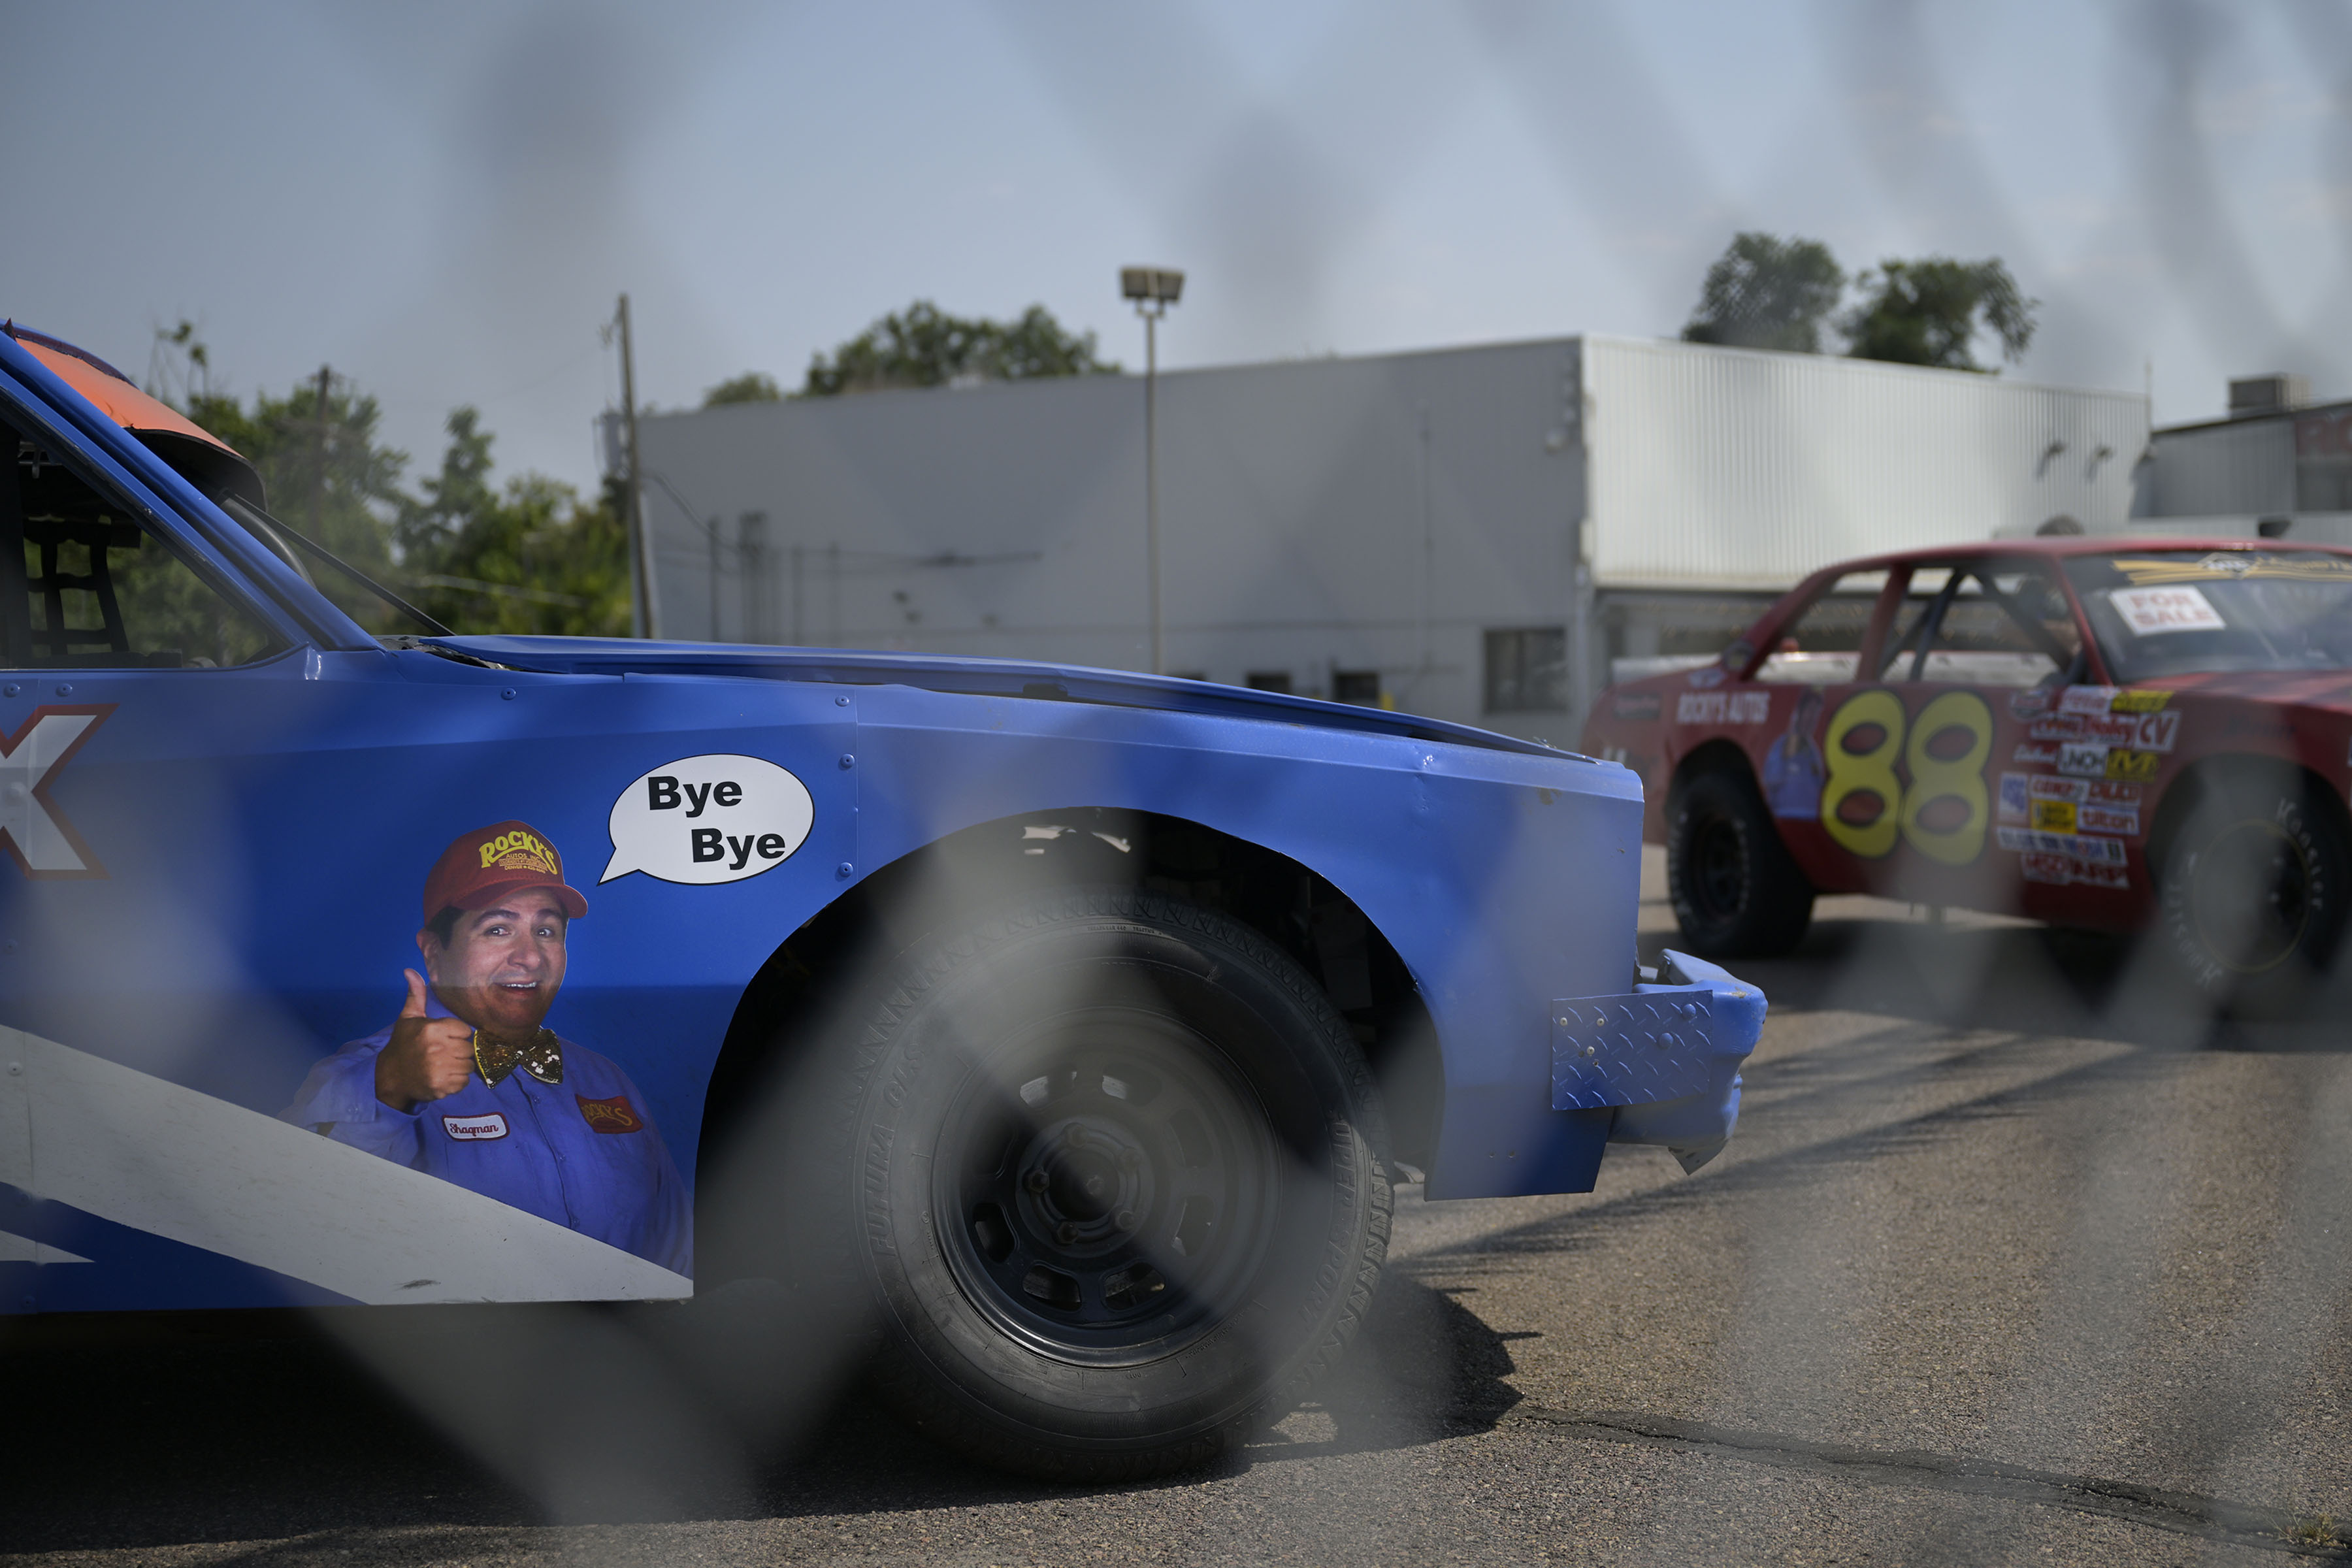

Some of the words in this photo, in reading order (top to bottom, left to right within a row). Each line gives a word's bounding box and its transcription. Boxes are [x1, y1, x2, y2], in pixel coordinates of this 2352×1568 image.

[2129, 593, 2195, 608] FOR
[2134, 610, 2213, 626] SALE
[647, 776, 743, 818] Bye
[1821, 689, 1993, 864] 88
[479, 830, 558, 875] ROCKY'S
[691, 827, 786, 870] Bye
[865, 1124, 896, 1258] FUTURA
[1298, 1223, 1353, 1325] SPORT
